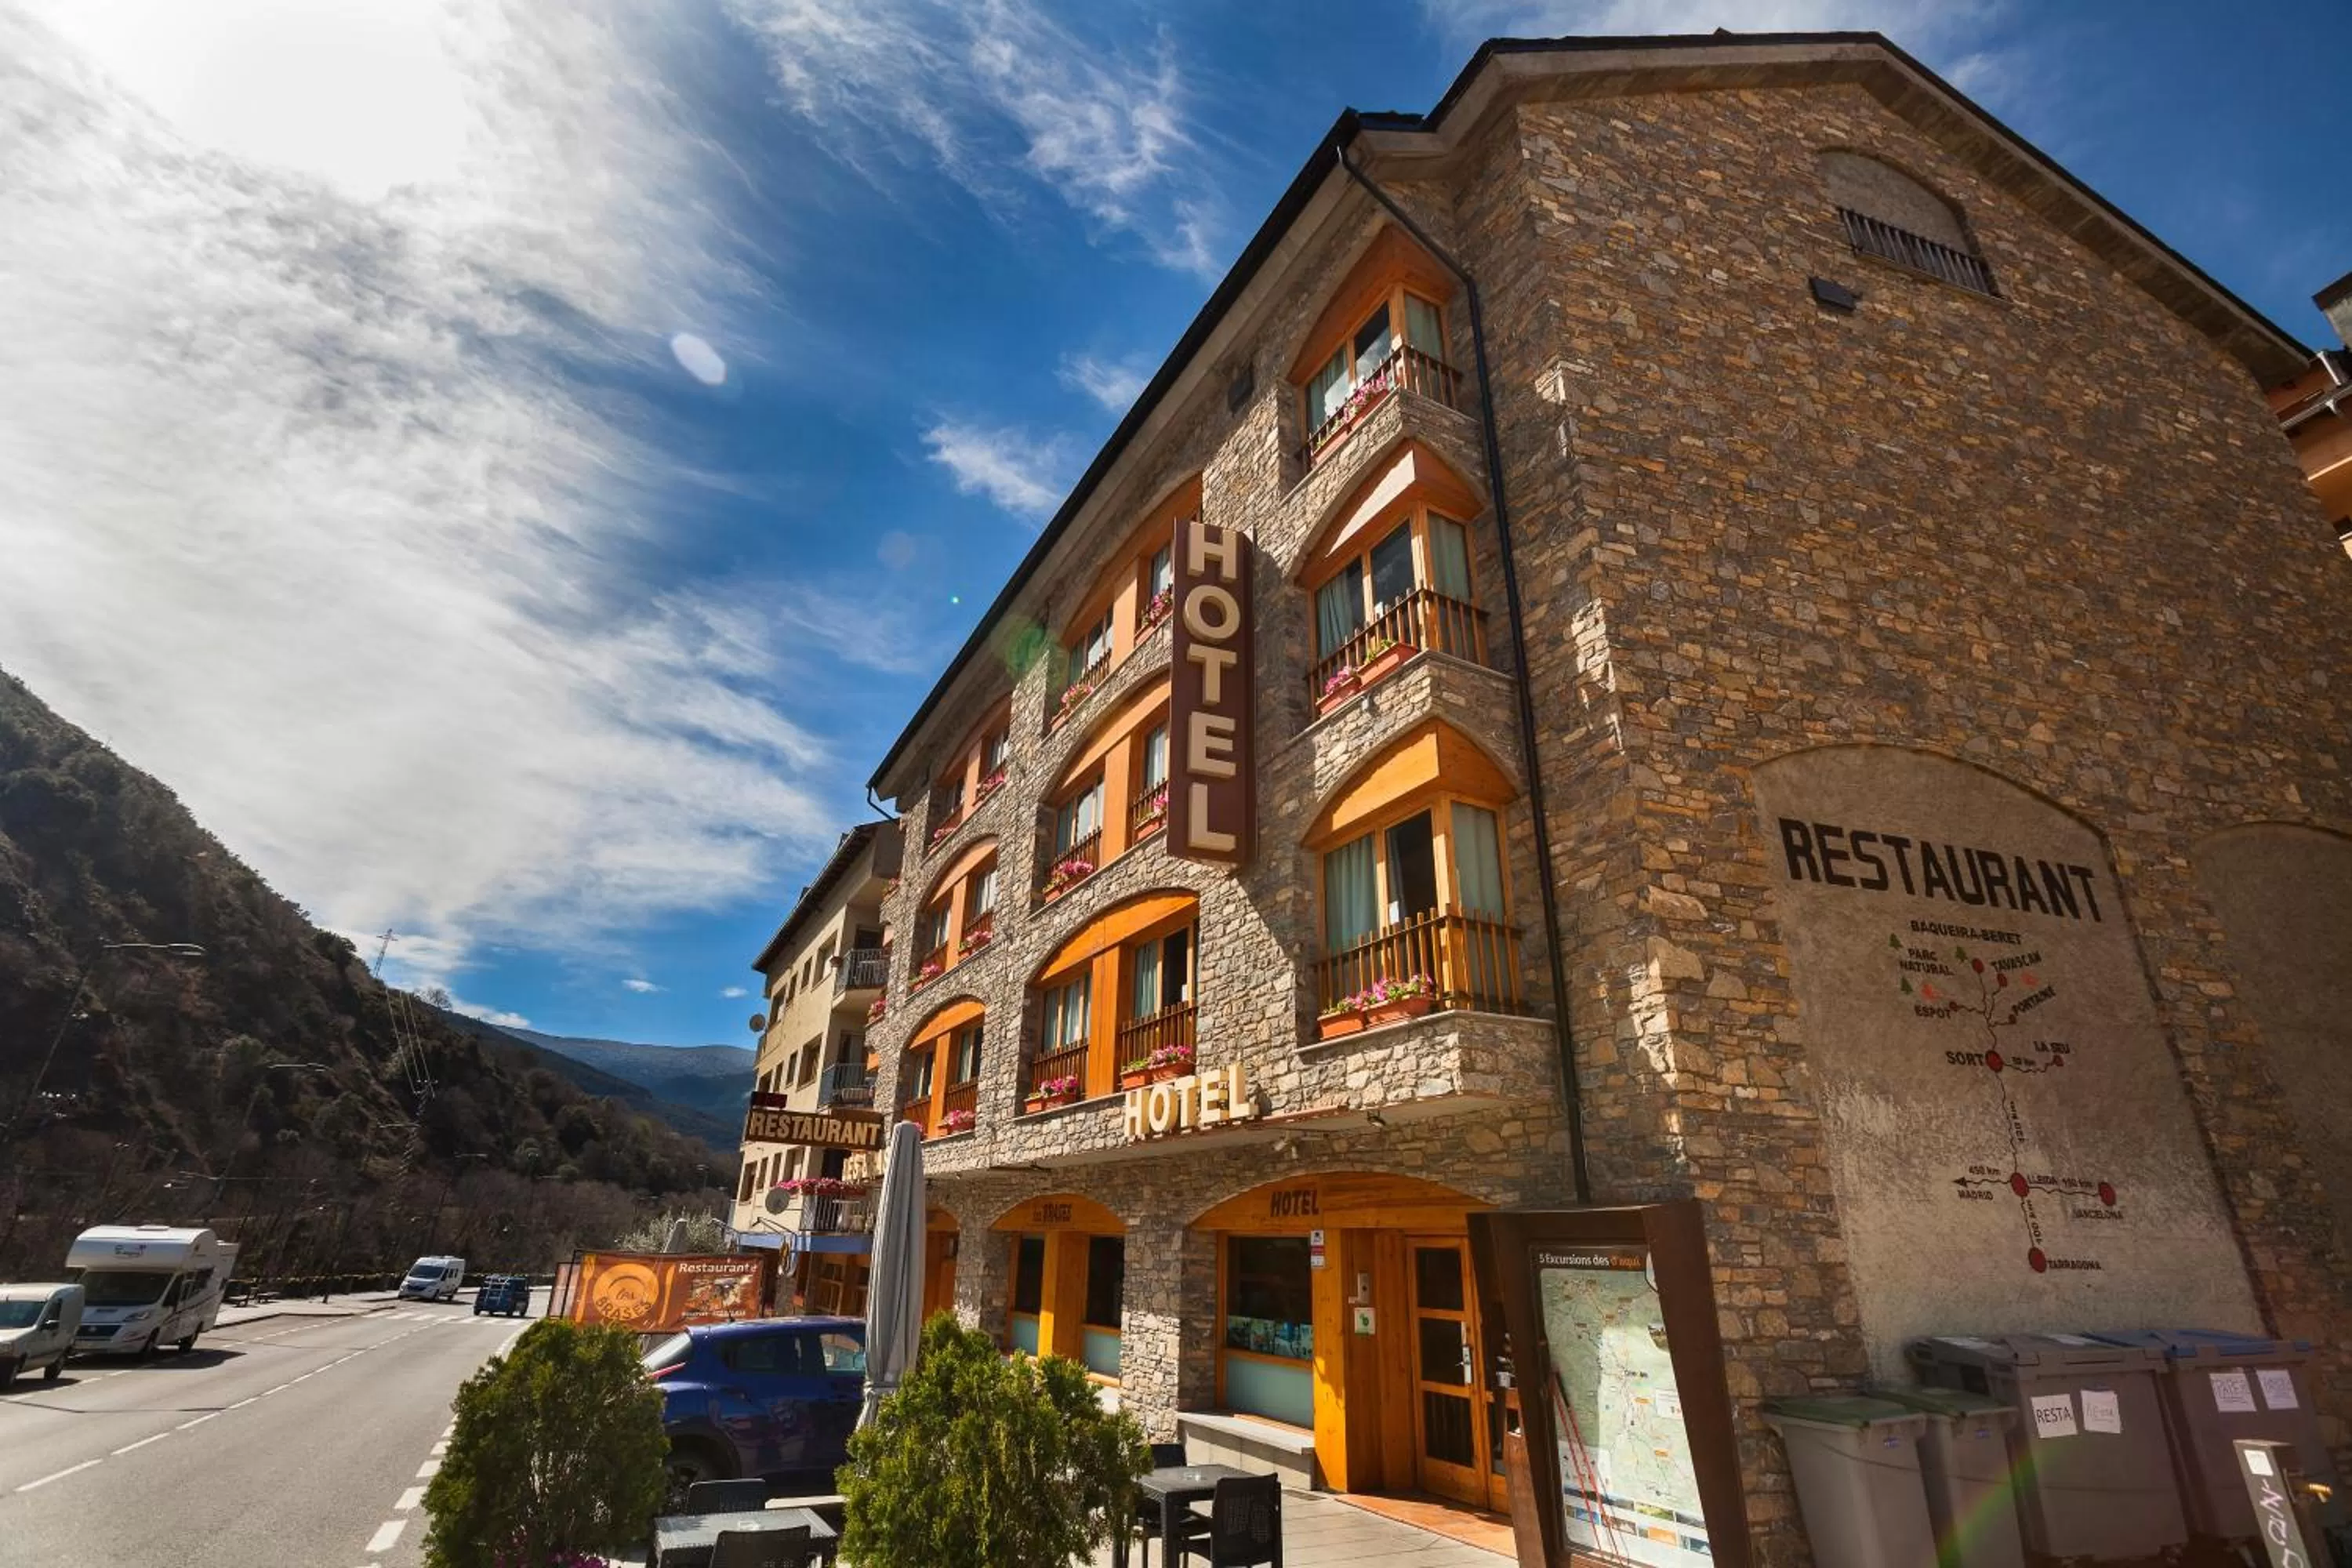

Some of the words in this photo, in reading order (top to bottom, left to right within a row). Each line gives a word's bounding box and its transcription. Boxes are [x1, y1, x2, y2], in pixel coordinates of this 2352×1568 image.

[1183, 521, 1241, 852] HOTEL
[1777, 817, 2102, 923] RESTAURANT
[1909, 920, 2022, 946] BAQUEIRA-BERET
[1907, 948, 1938, 961] PARC
[1900, 960, 1955, 976] NATURAL
[1914, 1004, 1951, 1019] ESPOT
[1945, 1051, 1984, 1066] SORT
[1124, 1062, 1254, 1138] HOTEL
[750, 1112, 881, 1146] RESTAURANT
[1270, 1189, 1319, 1218] HOTEL
[1958, 1189, 1994, 1201] MADRID
[678, 1262, 757, 1274] Restaurante
[1545, 1253, 1592, 1267] Excursions
[1592, 1254, 1610, 1267] des
[595, 1295, 653, 1320] BRASES
[2035, 1406, 2074, 1425] RESTA
